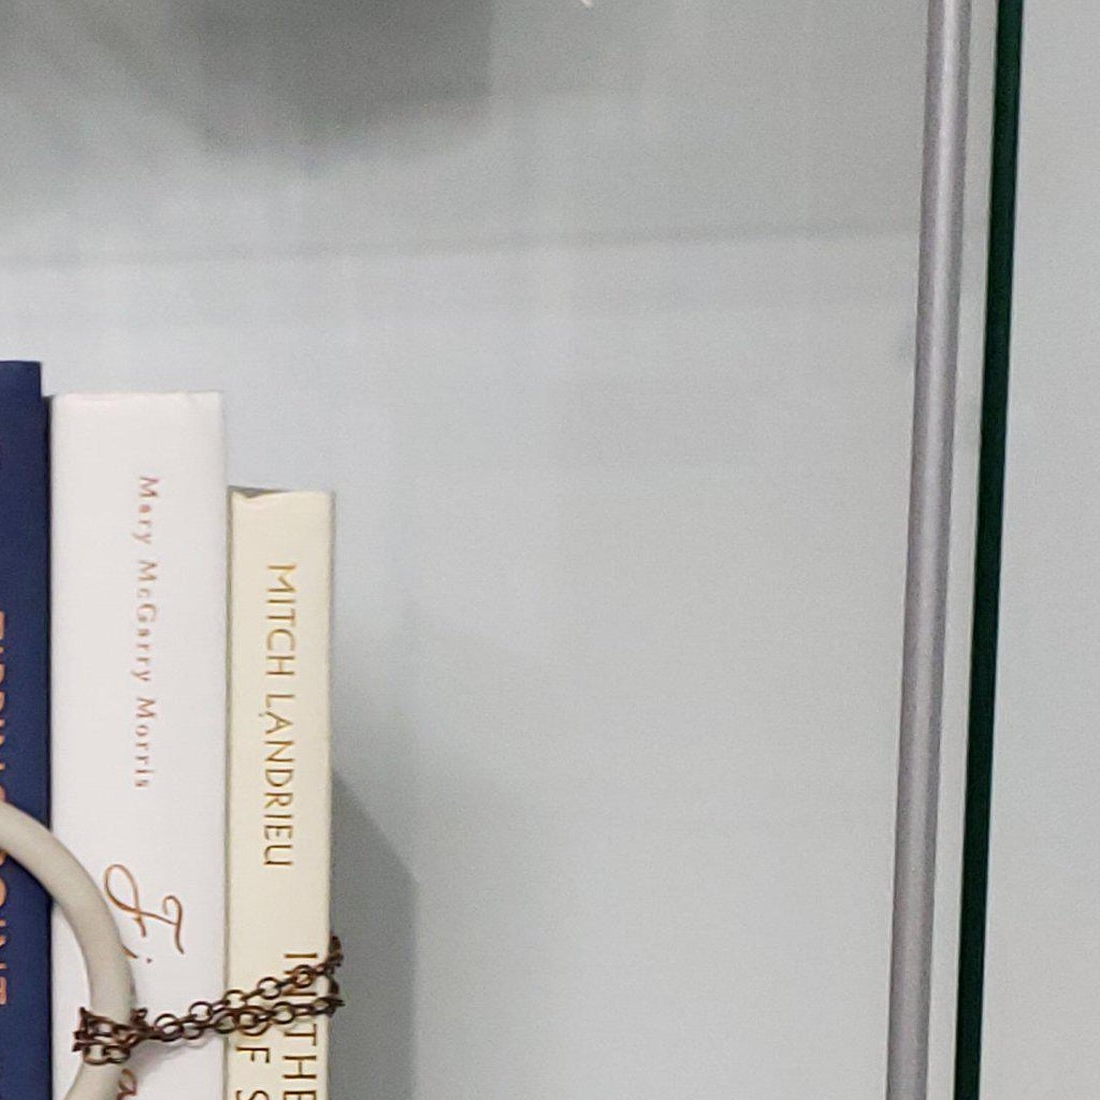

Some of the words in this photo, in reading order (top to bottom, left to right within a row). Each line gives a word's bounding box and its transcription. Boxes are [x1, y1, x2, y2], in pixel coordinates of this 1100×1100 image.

[131, 476, 159, 545] Mary
[130, 559, 158, 683] McGarry
[265, 563, 297, 677] MITCH
[134, 698, 156, 788] Morris
[261, 694, 296, 867] LANDRIEU
